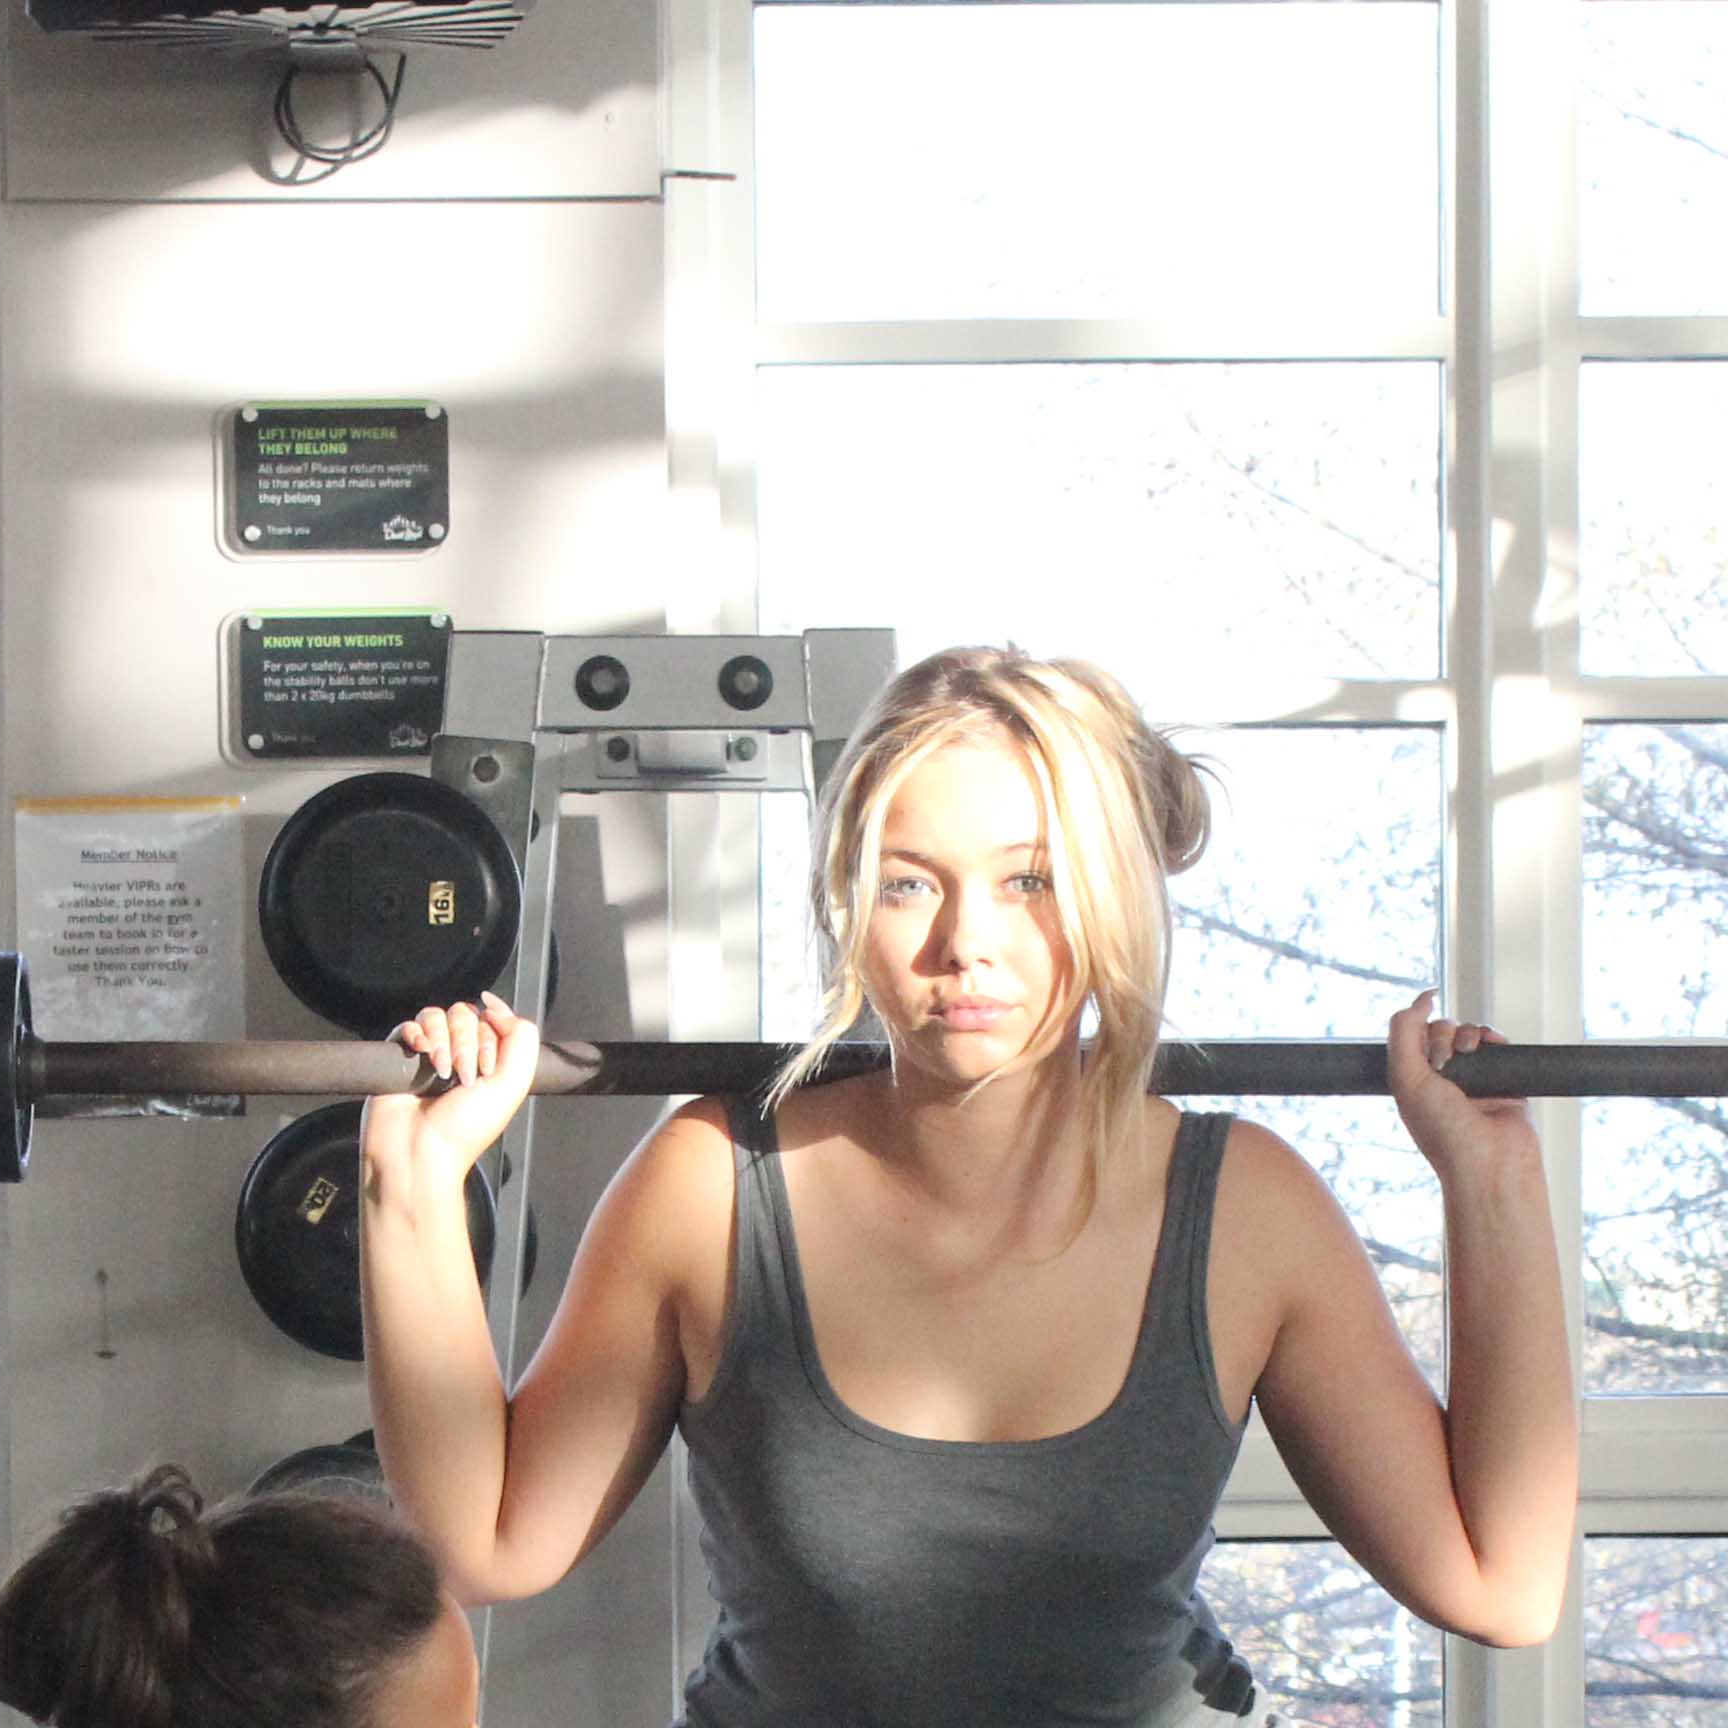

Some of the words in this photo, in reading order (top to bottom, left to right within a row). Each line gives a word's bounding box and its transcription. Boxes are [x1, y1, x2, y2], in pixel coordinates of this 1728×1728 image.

[258, 428, 290, 440] LIFT
[291, 427, 326, 440] THEM
[329, 427, 347, 439] UP
[350, 426, 398, 439] WHERE
[258, 443, 291, 455] THEY
[295, 442, 348, 455] BELONG
[258, 464, 272, 474] All
[276, 462, 308, 474] done?
[311, 464, 348, 474] Please
[350, 464, 384, 474] return
[387, 463, 430, 475] weights
[258, 480, 270, 489] to
[272, 479, 289, 489] the
[292, 478, 322, 489] racks
[325, 478, 346, 489] and
[348, 479, 377, 488] mats
[378, 477, 413, 488] where
[258, 493, 282, 506] they
[284, 493, 321, 506] belong
[267, 525, 291, 535] Thank
[294, 527, 310, 537] you
[263, 635, 304, 649] KNOW
[306, 635, 342, 648] YOUR
[345, 634, 403, 648] WEIGHTS
[263, 660, 281, 672] For
[285, 662, 308, 675] your
[349, 660, 378, 671] when
[416, 661, 430, 670] on
[263, 676, 281, 687] the
[285, 675, 326, 688] stability
[329, 675, 355, 686] balls
[388, 676, 408, 685] use
[411, 676, 438, 685] more
[264, 690, 289, 701] than
[291, 690, 298, 701] 2
[310, 690, 335, 703] 20kg
[338, 689, 395, 701] dumbbells
[80, 850, 131, 861] Member
[136, 849, 177, 861] Notice
[165, 882, 186, 891] are
[124, 897, 165, 909] please
[169, 896, 189, 907] ask
[193, 898, 201, 907] a
[68, 913, 119, 924] member
[125, 912, 138, 923] of
[141, 912, 162, 923] the
[167, 915, 192, 926] gym
[63, 930, 95, 940] team
[99, 930, 113, 940] to
[116, 929, 147, 940] book
[95, 945, 140, 956] session
[144, 946, 160, 955] on
[67, 964, 89, 973] use
[93, 961, 127, 973] them
